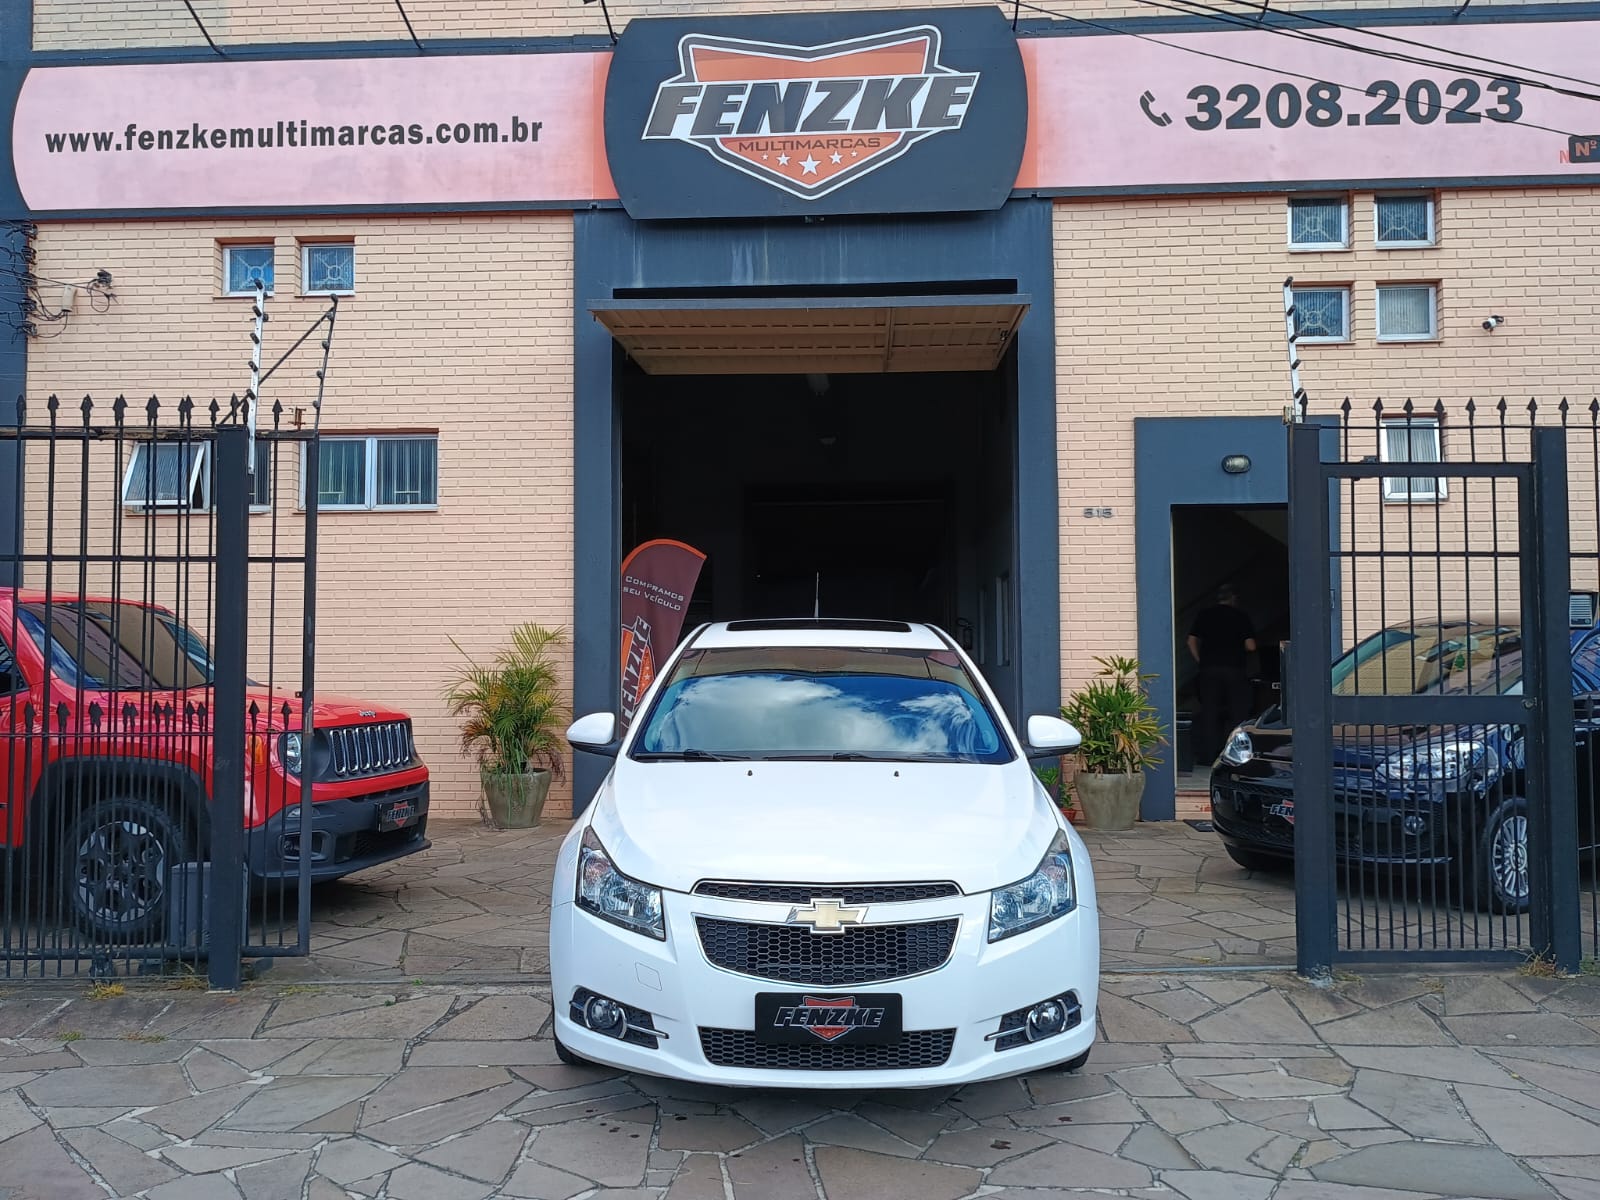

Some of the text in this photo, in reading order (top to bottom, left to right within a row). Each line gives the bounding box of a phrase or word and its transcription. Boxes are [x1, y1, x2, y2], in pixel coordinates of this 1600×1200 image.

[643, 74, 978, 137] FENZKE
[1185, 78, 1523, 130] 3208.2023
[45, 116, 543, 152] www.fenzkemultimarcas.com.br
[738, 137, 881, 152] MULTIMARCAS
[620, 616, 651, 727] FENZKE
[1269, 804, 1294, 816] FEN
[774, 1007, 885, 1027] FENZKE
